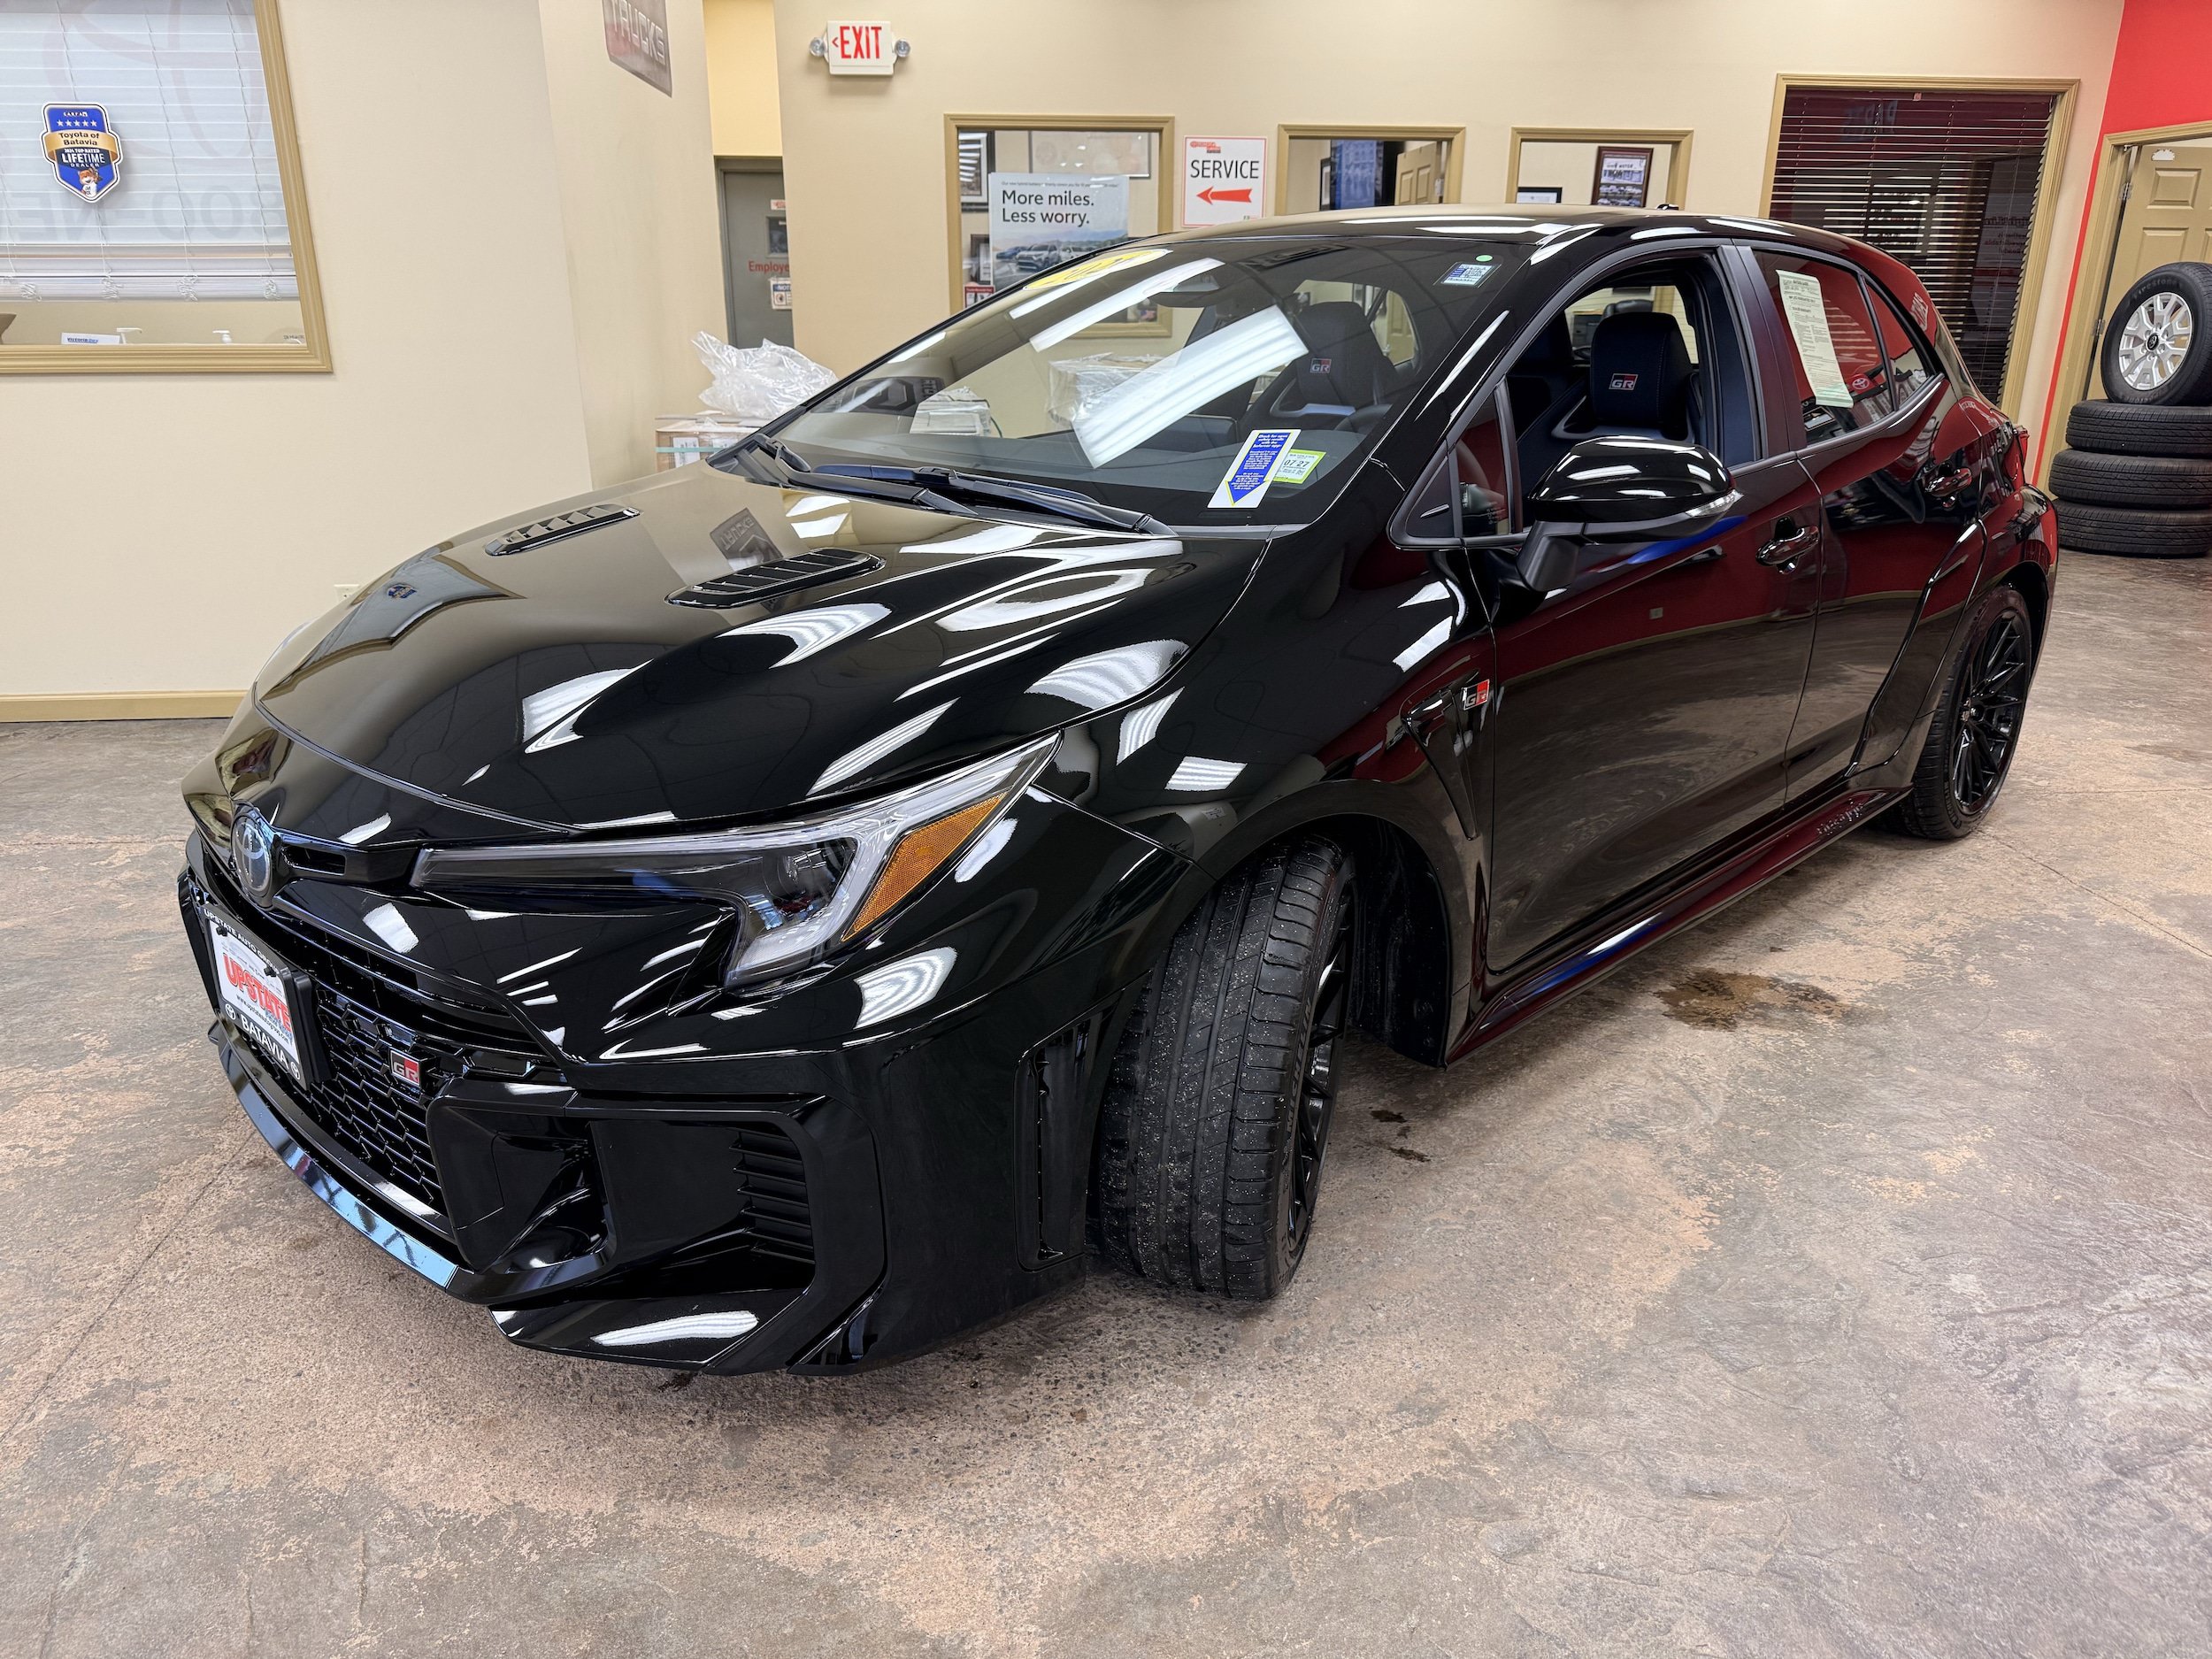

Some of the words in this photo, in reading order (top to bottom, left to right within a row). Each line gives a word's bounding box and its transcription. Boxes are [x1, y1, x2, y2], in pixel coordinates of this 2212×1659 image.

[840, 26, 882, 59] EXIT
[61, 153, 106, 164] LIFETIME
[1190, 159, 1260, 179] SERVICE
[1002, 189, 1043, 205] More
[1048, 190, 1094, 206] miles.
[1002, 208, 1036, 223] Less
[1041, 211, 1090, 227] worry.
[1465, 690, 1488, 708] GR
[204, 908, 238, 938] UPSTATE
[238, 933, 257, 952] AUTO
[222, 952, 293, 1034] UPSTATE
[241, 1013, 290, 1070] BATAVIA
[393, 1061, 419, 1085] GR
[1286, 996, 1311, 1133] MICHELIN
